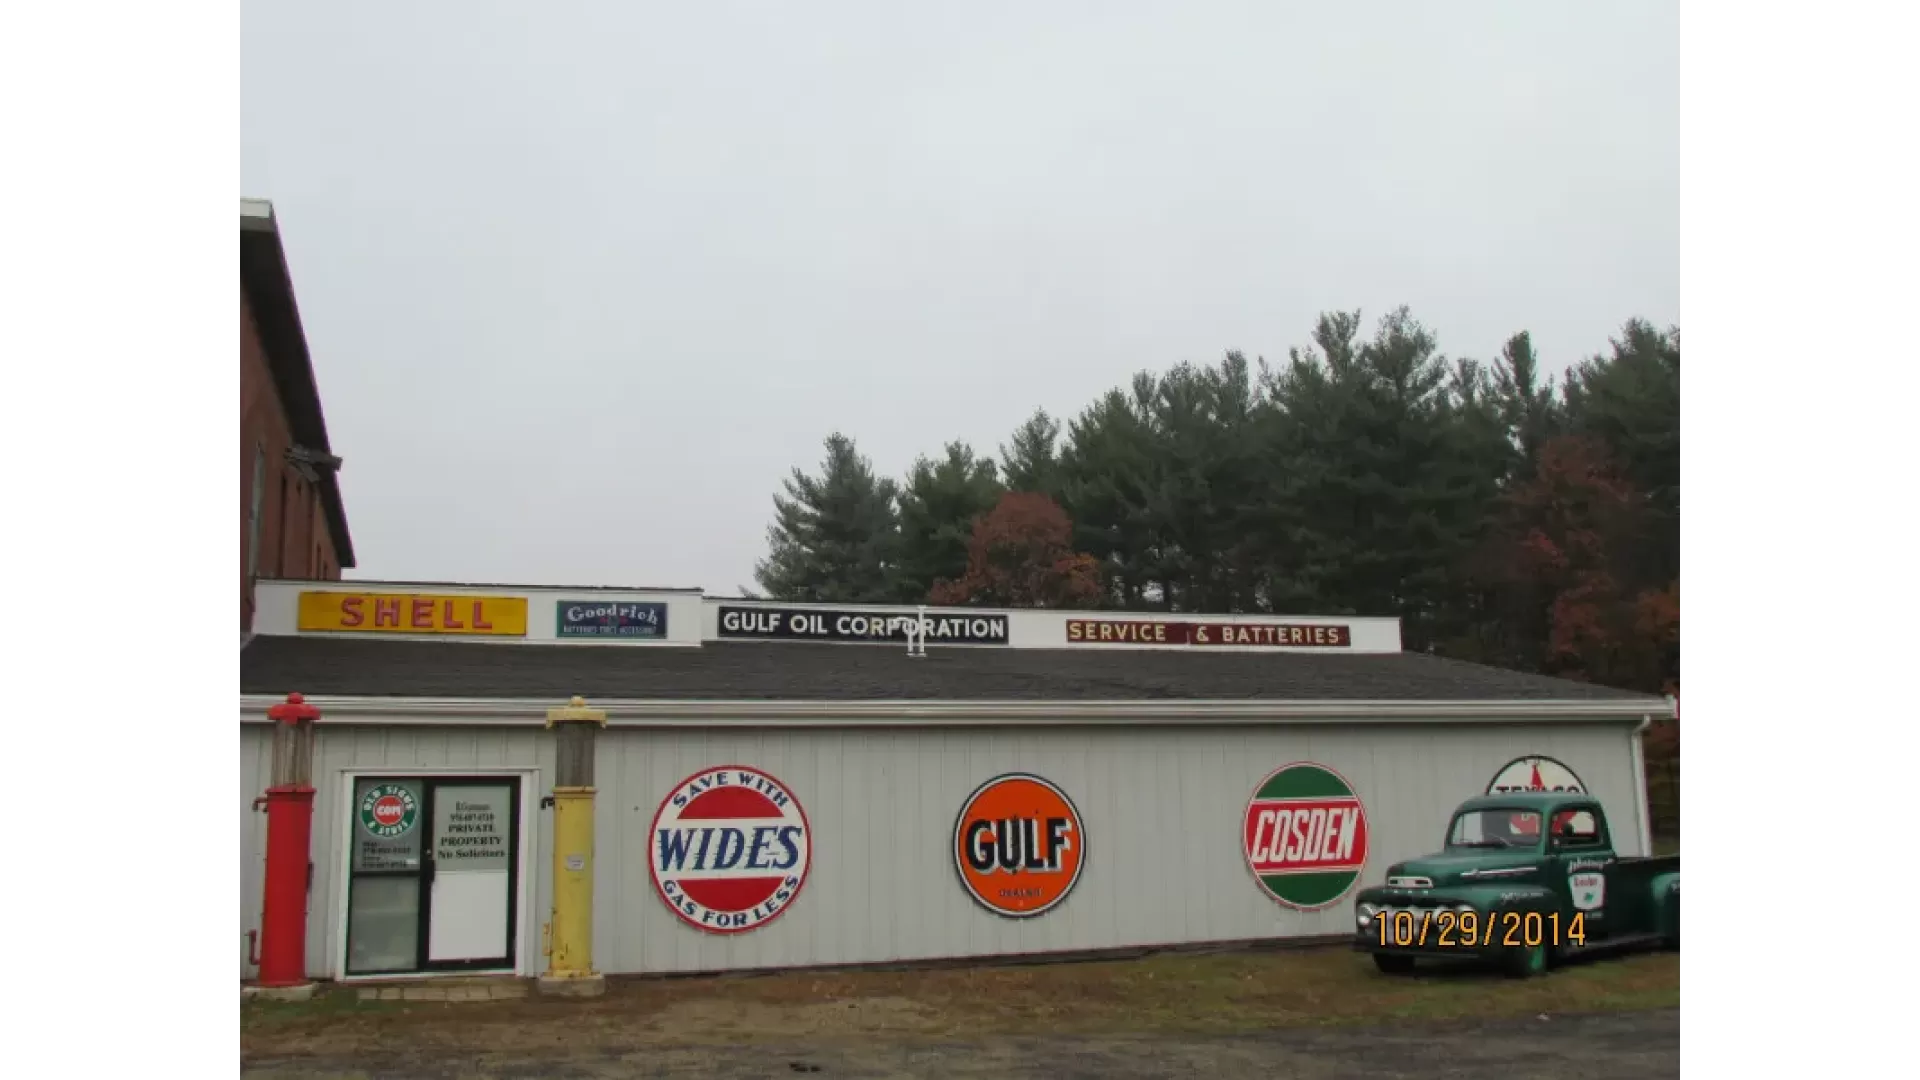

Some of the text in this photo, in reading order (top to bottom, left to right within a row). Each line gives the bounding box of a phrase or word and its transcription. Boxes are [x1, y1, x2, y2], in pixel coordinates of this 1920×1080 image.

[340, 596, 493, 630] SHELL
[567, 603, 658, 625] Goodrich
[723, 611, 1004, 639] GULF OIL CORPORATION
[1069, 621, 1340, 644] SERVICE & BATTERIES
[673, 771, 789, 809] SAVE WITH
[441, 836, 502, 847] PROPERTY
[448, 823, 494, 833] PRIVATE
[1251, 807, 1359, 863] COSDEN
[438, 849, 454, 860] No
[657, 825, 802, 872] WIDES
[965, 817, 1072, 875] GULF
[663, 874, 799, 927] GAS FOR LESS
